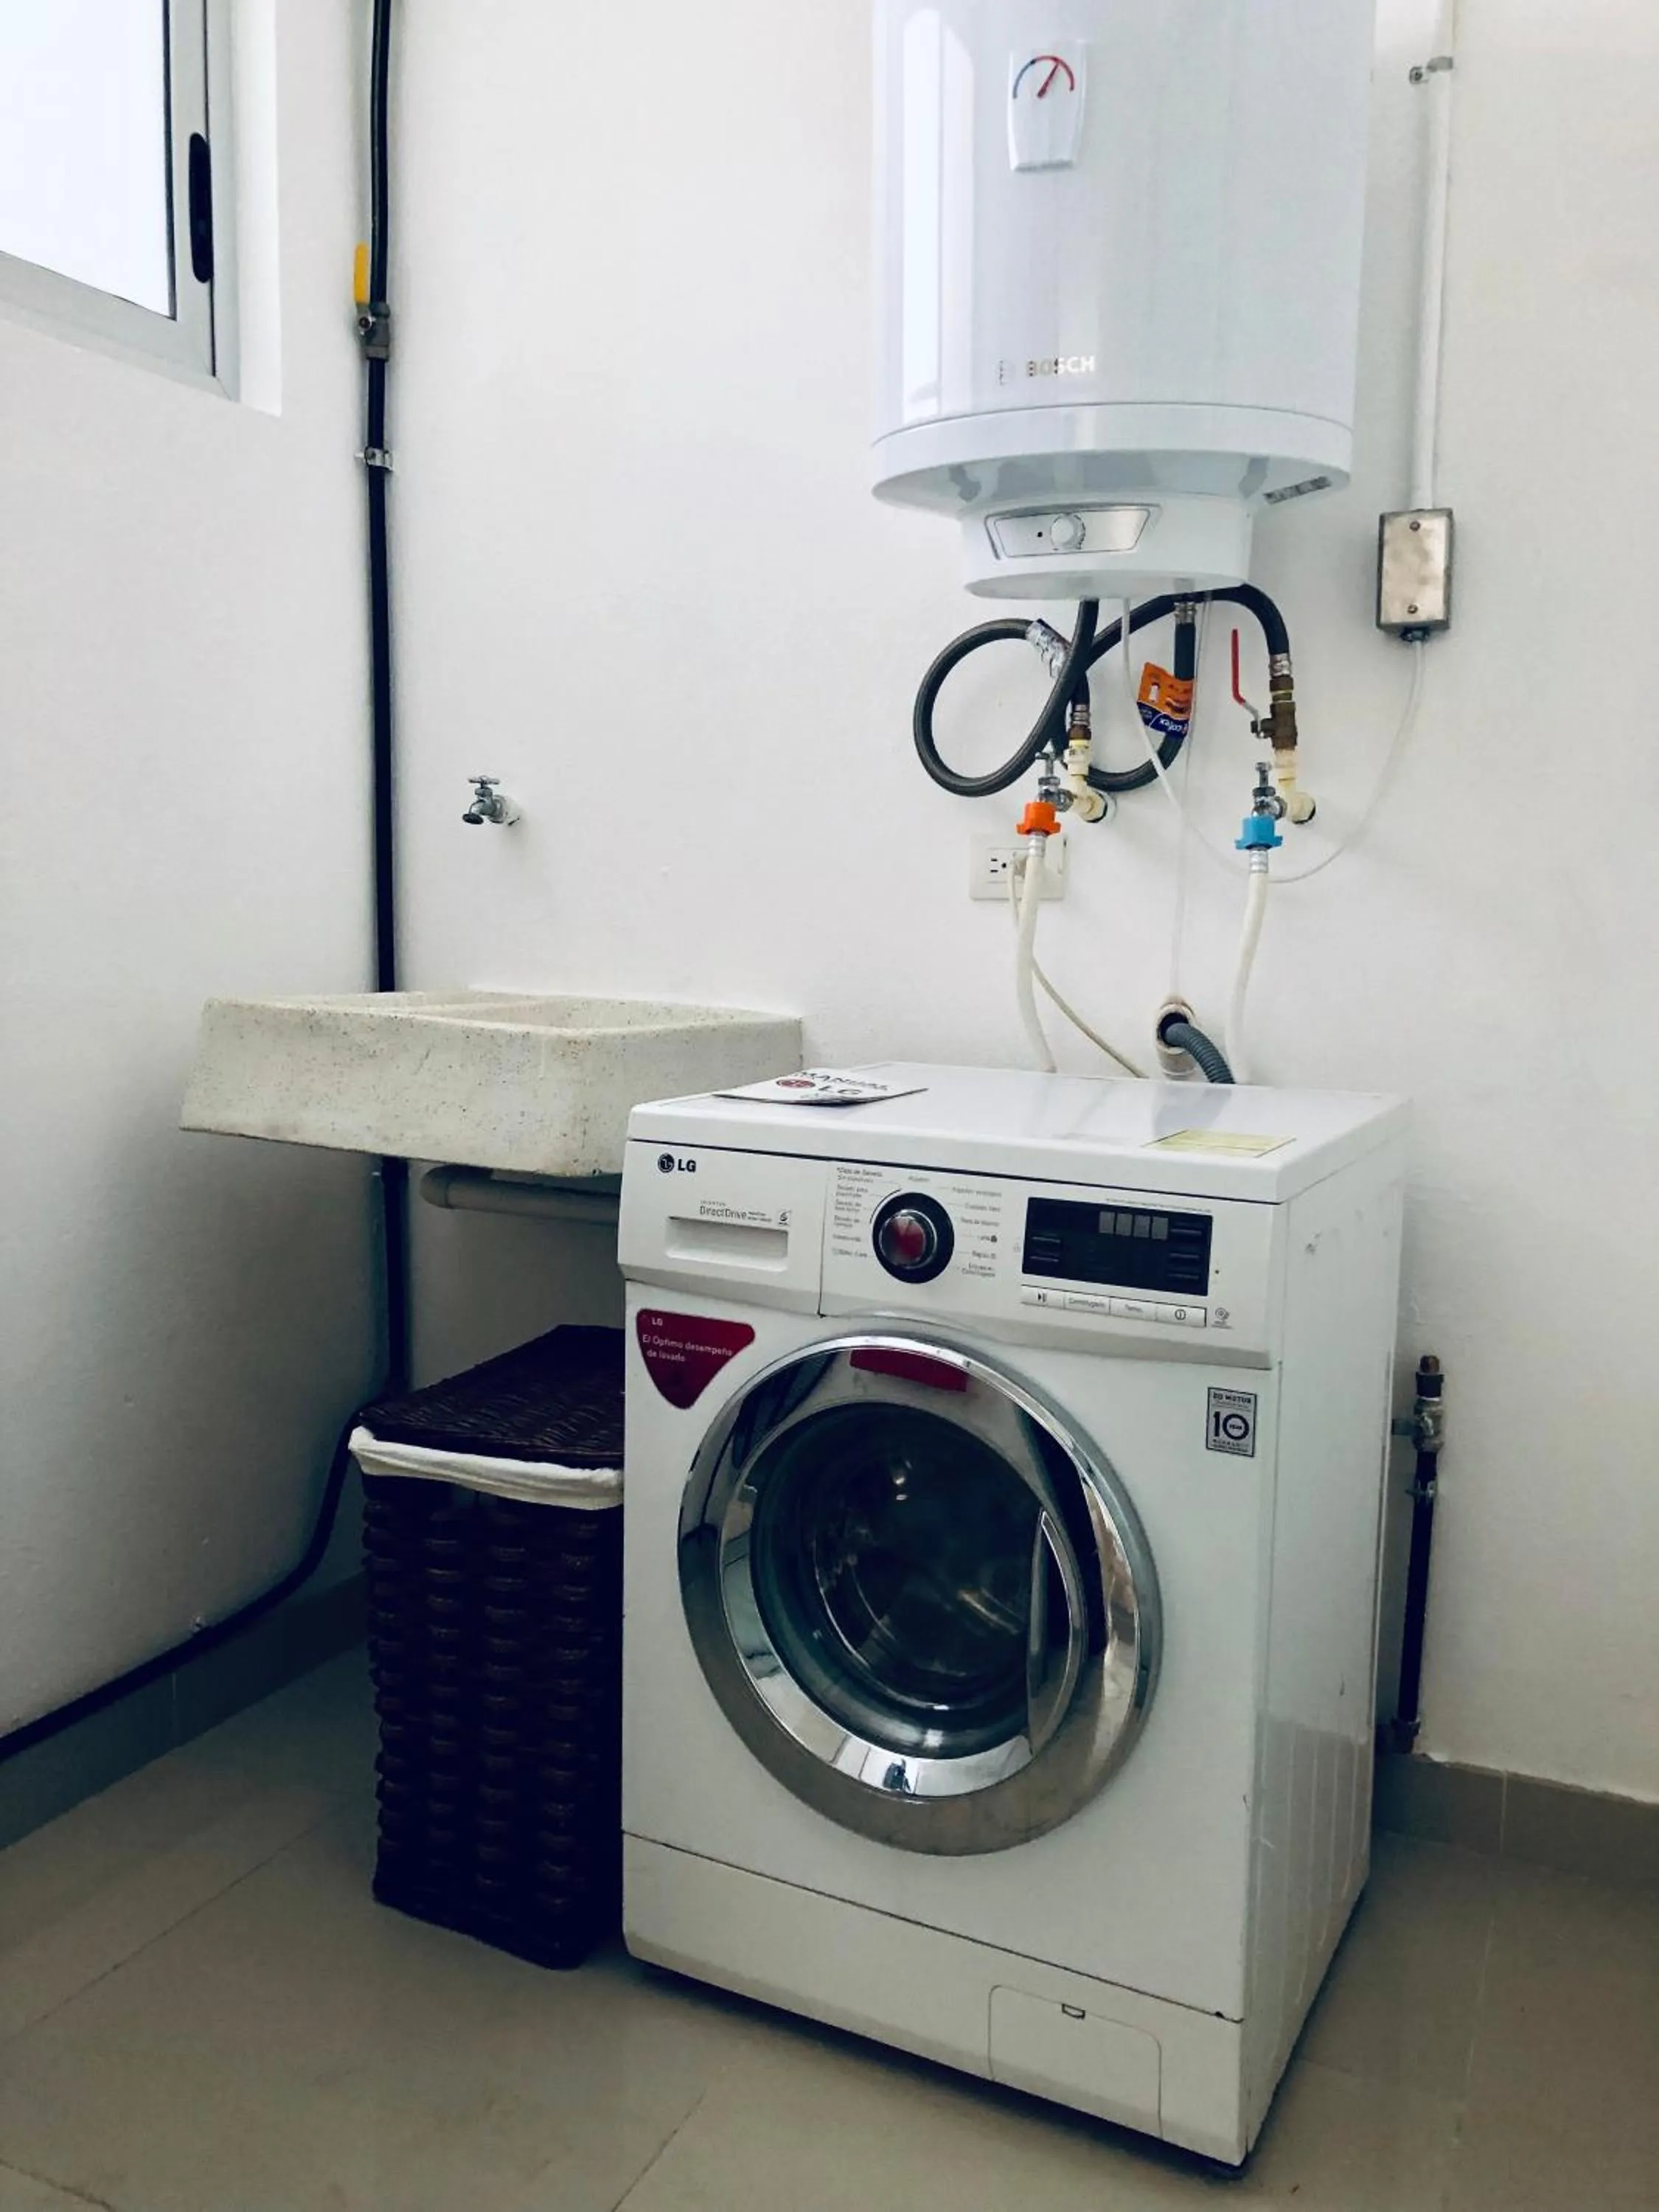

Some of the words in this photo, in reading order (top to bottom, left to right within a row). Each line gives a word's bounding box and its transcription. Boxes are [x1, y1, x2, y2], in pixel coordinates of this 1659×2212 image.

[1026, 356, 1096, 378] BOSCH
[678, 1158, 697, 1173] LG
[652, 1317, 663, 1326] LG
[642, 1334, 651, 1343] El
[647, 1349, 657, 1358] de
[658, 1351, 686, 1362] lavado
